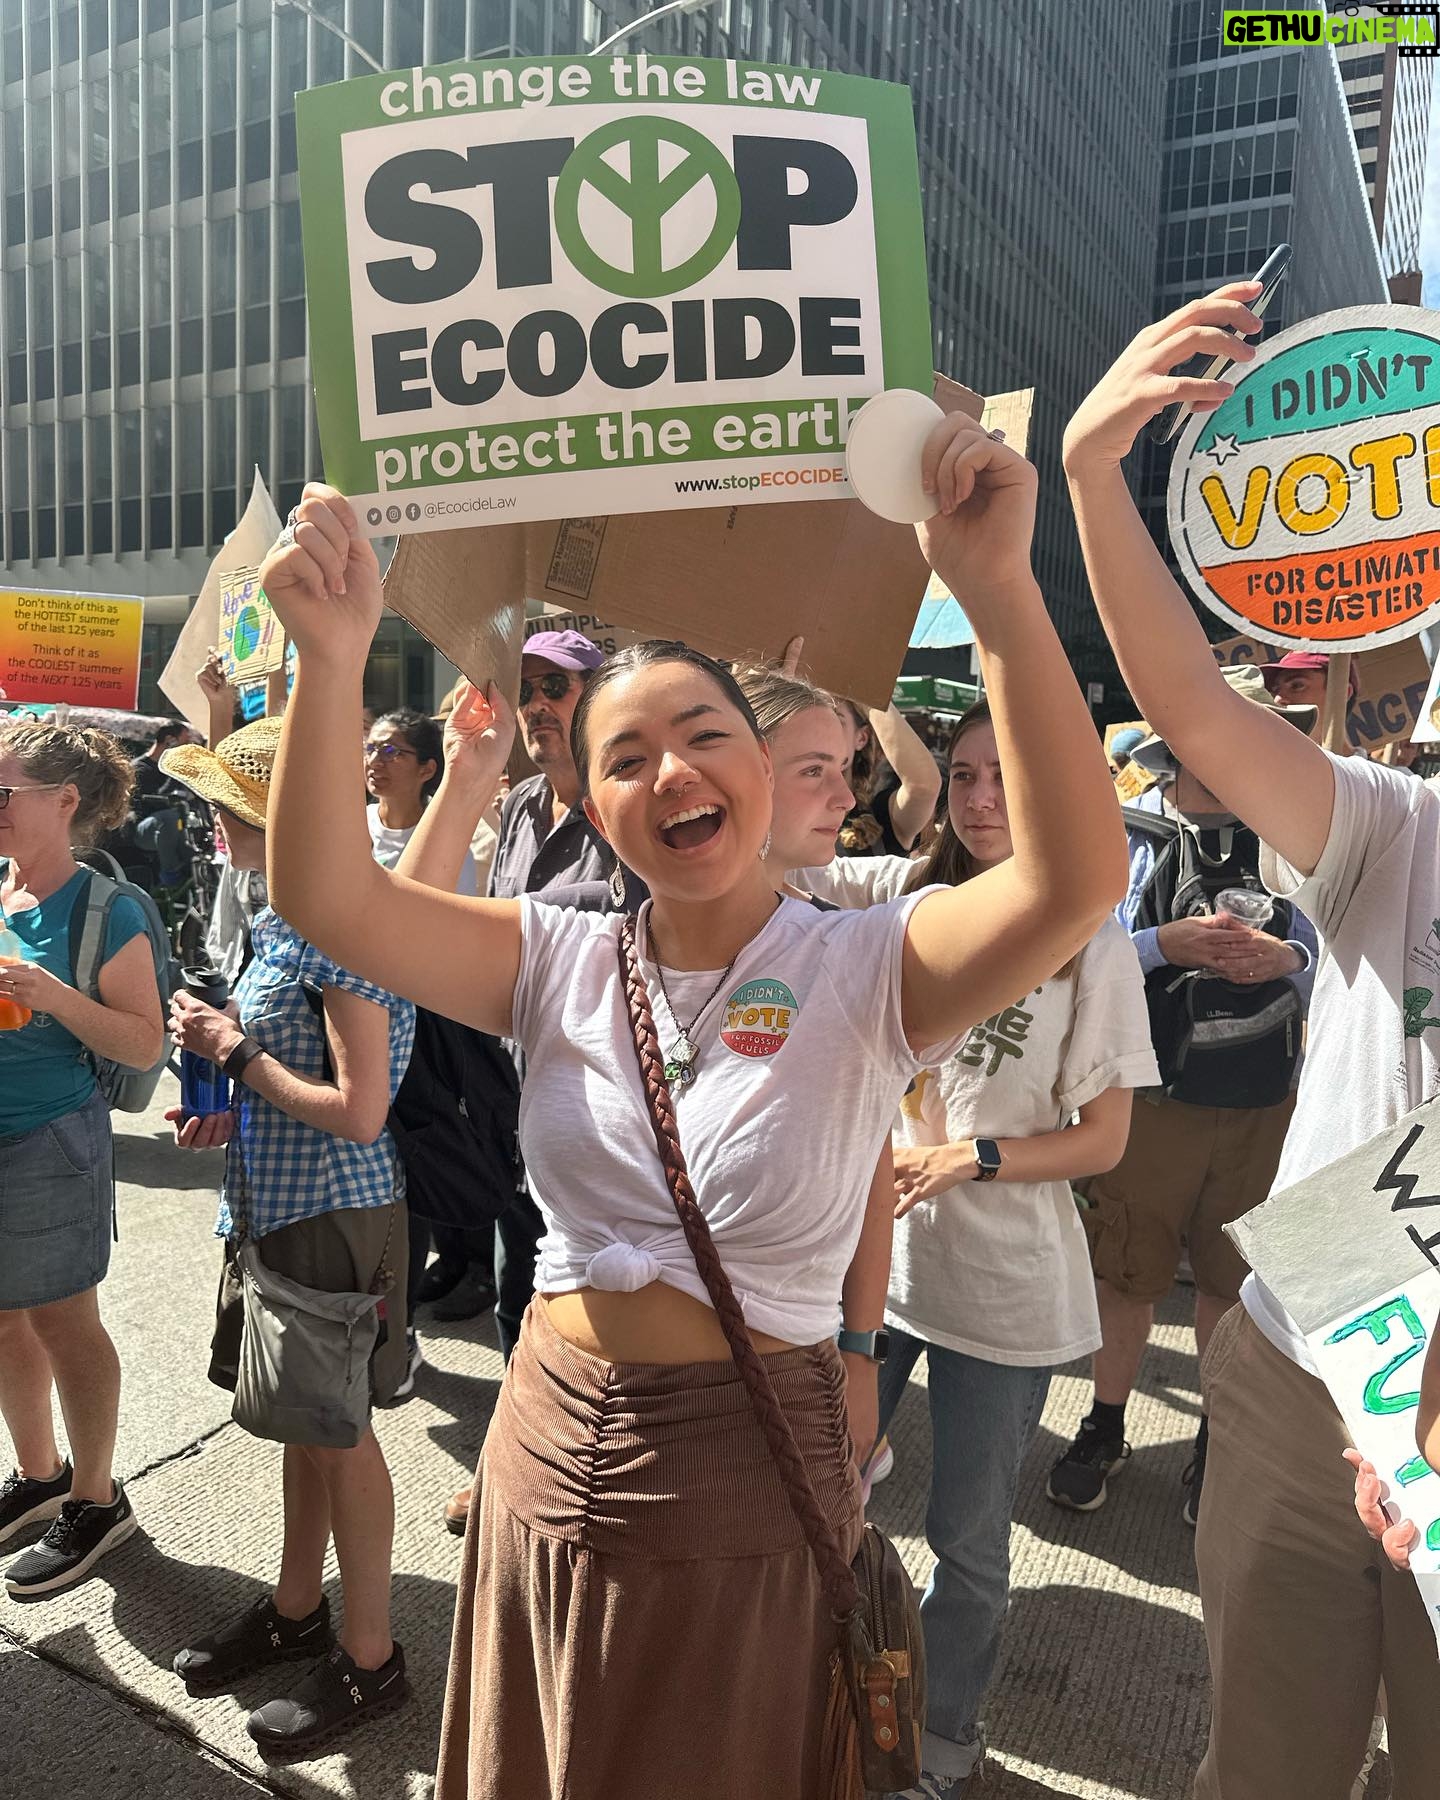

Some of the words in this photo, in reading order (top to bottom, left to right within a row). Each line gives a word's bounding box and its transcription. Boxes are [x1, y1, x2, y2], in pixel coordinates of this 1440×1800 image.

[380, 63, 592, 118] change
[610, 54, 706, 98] the
[726, 58, 822, 107] law
[371, 297, 866, 415] ECOCIDE
[1245, 394, 1254, 427] I
[1271, 353, 1433, 421] DIDN'T
[375, 421, 577, 493] protect
[596, 411, 692, 462] the
[424, 496, 517, 519] @EcocideLaw
[1247, 568, 1305, 597] FOR
[18, 597, 45, 608] Don't
[47, 599, 72, 610] think
[74, 601, 85, 611] of
[87, 602, 105, 613] this
[107, 605, 118, 614] as
[1272, 582, 1423, 626] DISASTER
[14, 609, 31, 620] the
[33, 610, 77, 622] HOTTEST
[79, 614, 120, 626] summer
[18, 621, 29, 631] of
[31, 622, 47, 633] the
[49, 624, 65, 634] last
[68, 625, 87, 636] 125
[89, 628, 116, 638] years
[33, 643, 62, 656] Think
[63, 646, 75, 656] of
[78, 648, 85, 658] it
[87, 650, 100, 659] as
[8, 657, 26, 669] the
[28, 658, 76, 672] COOLEST
[79, 663, 124, 675] summer
[7, 671, 19, 682] of
[21, 673, 38, 684] the
[41, 674, 70, 686] NEXT
[72, 676, 91, 688] 125
[94, 679, 123, 690] years
[727, 1007, 791, 1029] VOTE
[731, 1033, 746, 1042] FOR
[749, 1035, 780, 1047] FOSSIL
[740, 1043, 770, 1055] FUELS
